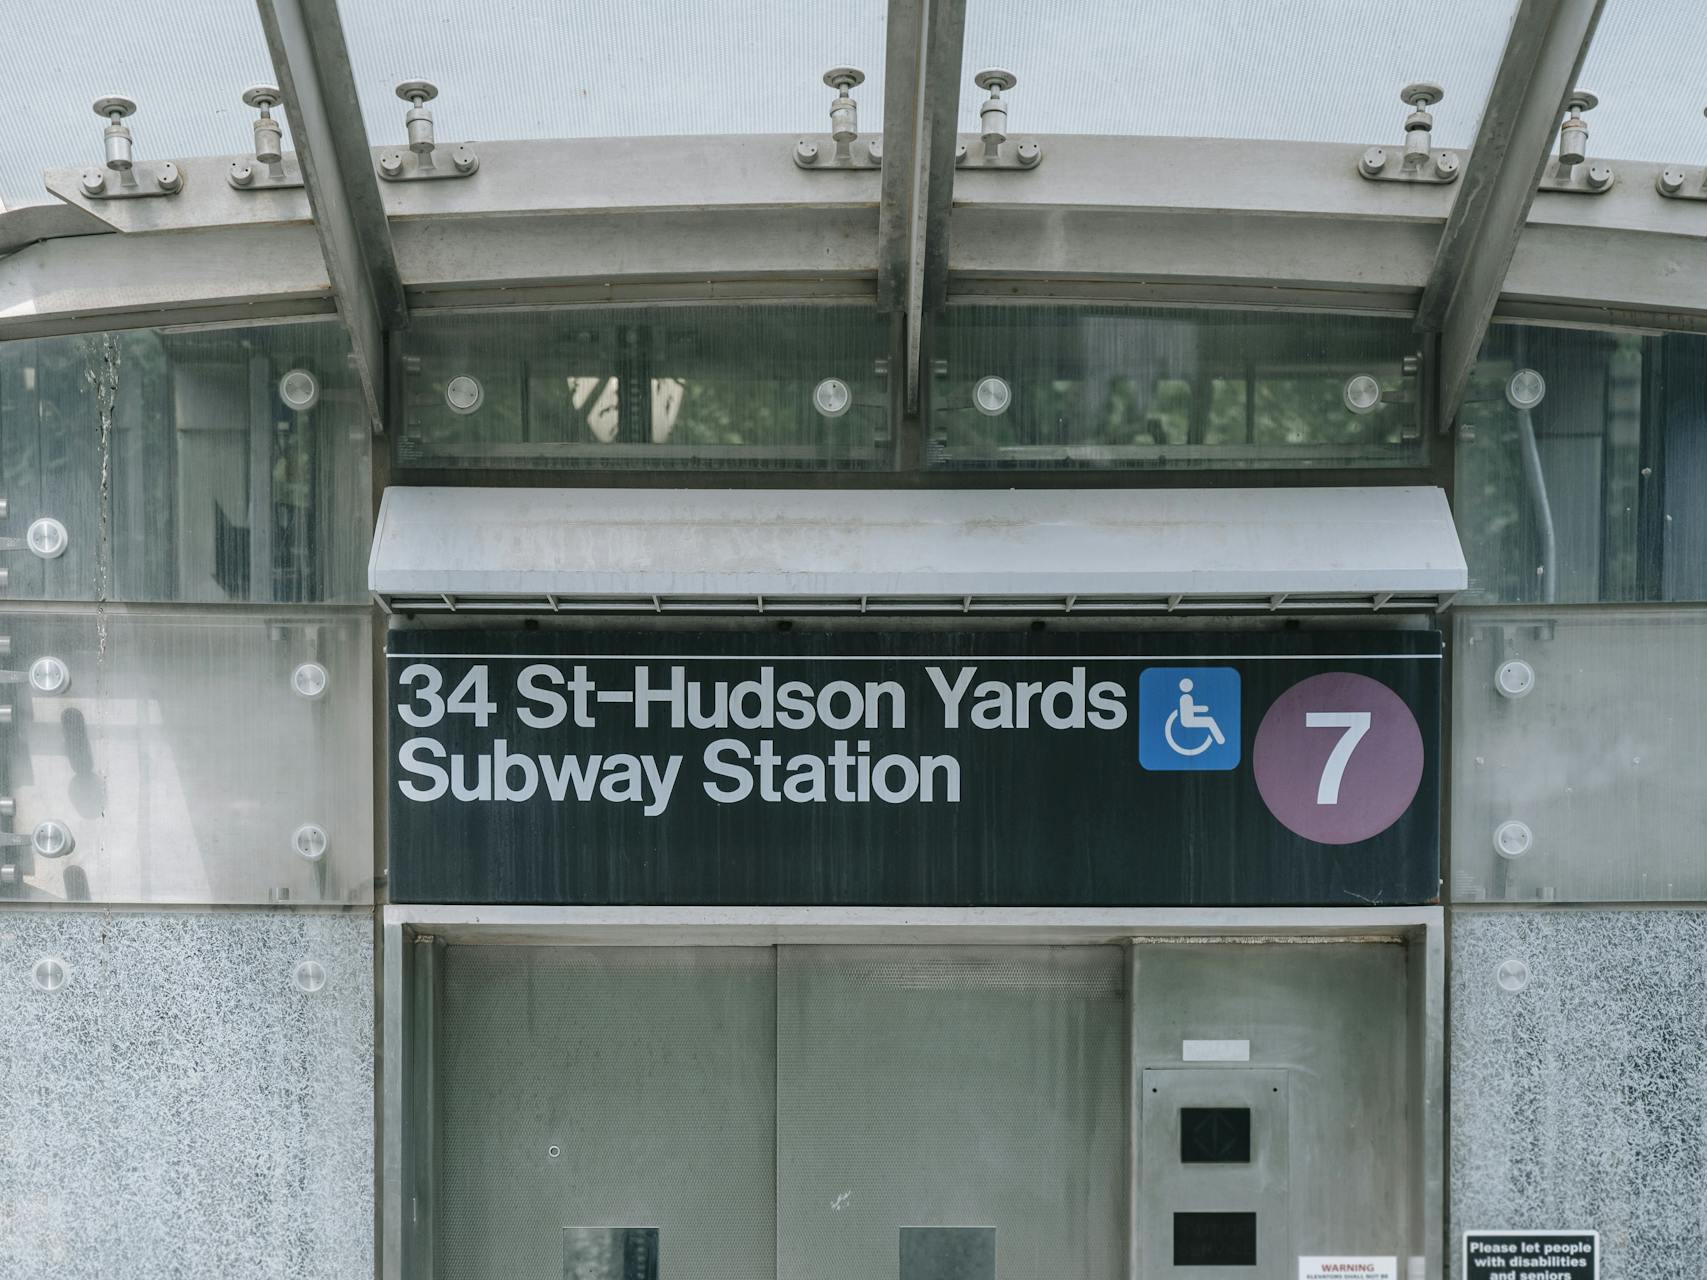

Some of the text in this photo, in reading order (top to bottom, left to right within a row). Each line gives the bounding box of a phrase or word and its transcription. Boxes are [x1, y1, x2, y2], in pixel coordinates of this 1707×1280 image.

[397, 665, 495, 728] 34
[925, 665, 1126, 730] Yards
[1305, 711, 1372, 806] 7
[397, 739, 961, 816] Subway Station
[1470, 1242, 1591, 1254] Please let people
[1321, 1264, 1375, 1272] WARNING
[1475, 1257, 1587, 1267] with disabilities
[1490, 1271, 1571, 1280] and seniors
